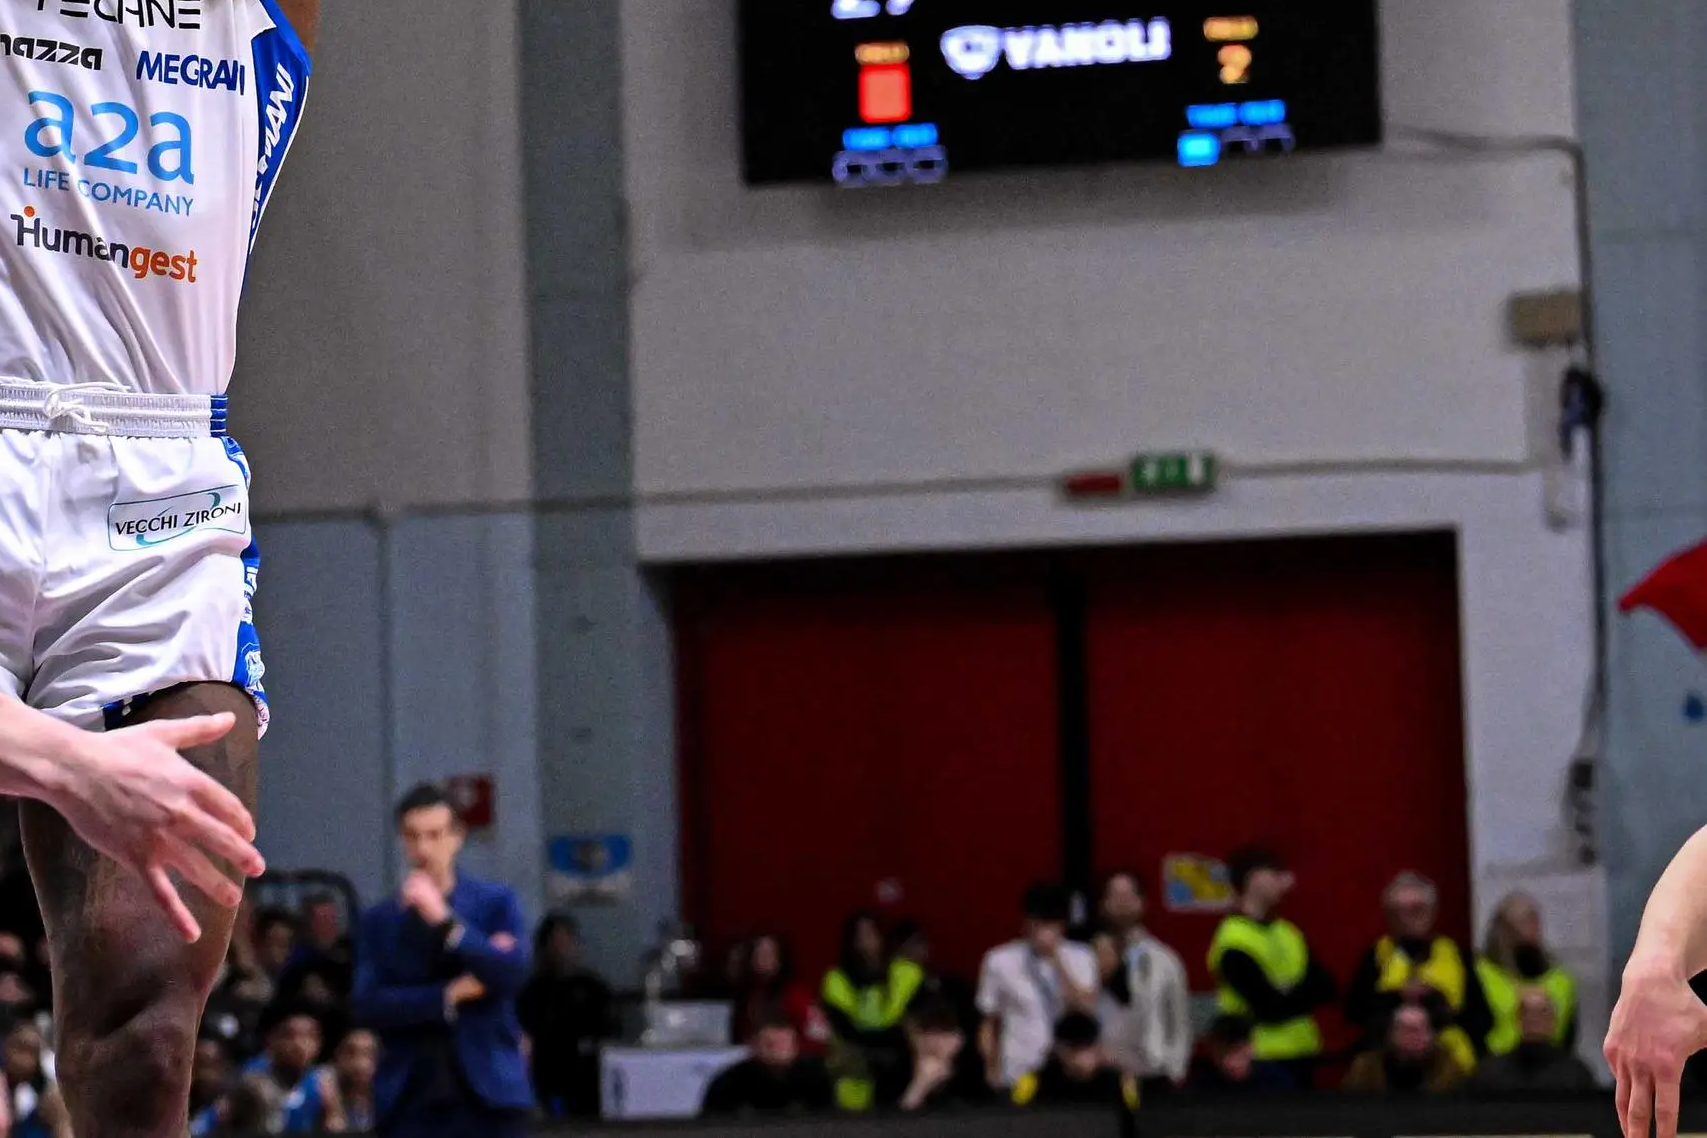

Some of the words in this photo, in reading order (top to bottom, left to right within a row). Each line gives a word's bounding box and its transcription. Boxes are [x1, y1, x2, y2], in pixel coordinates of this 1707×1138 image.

[24, 90, 195, 185] a2a
[23, 167, 70, 191] LIFE
[77, 179, 195, 216] COMPANY
[10, 212, 198, 284] Humangest
[115, 514, 178, 536] VECCHI
[183, 502, 242, 528] ZIRONI
